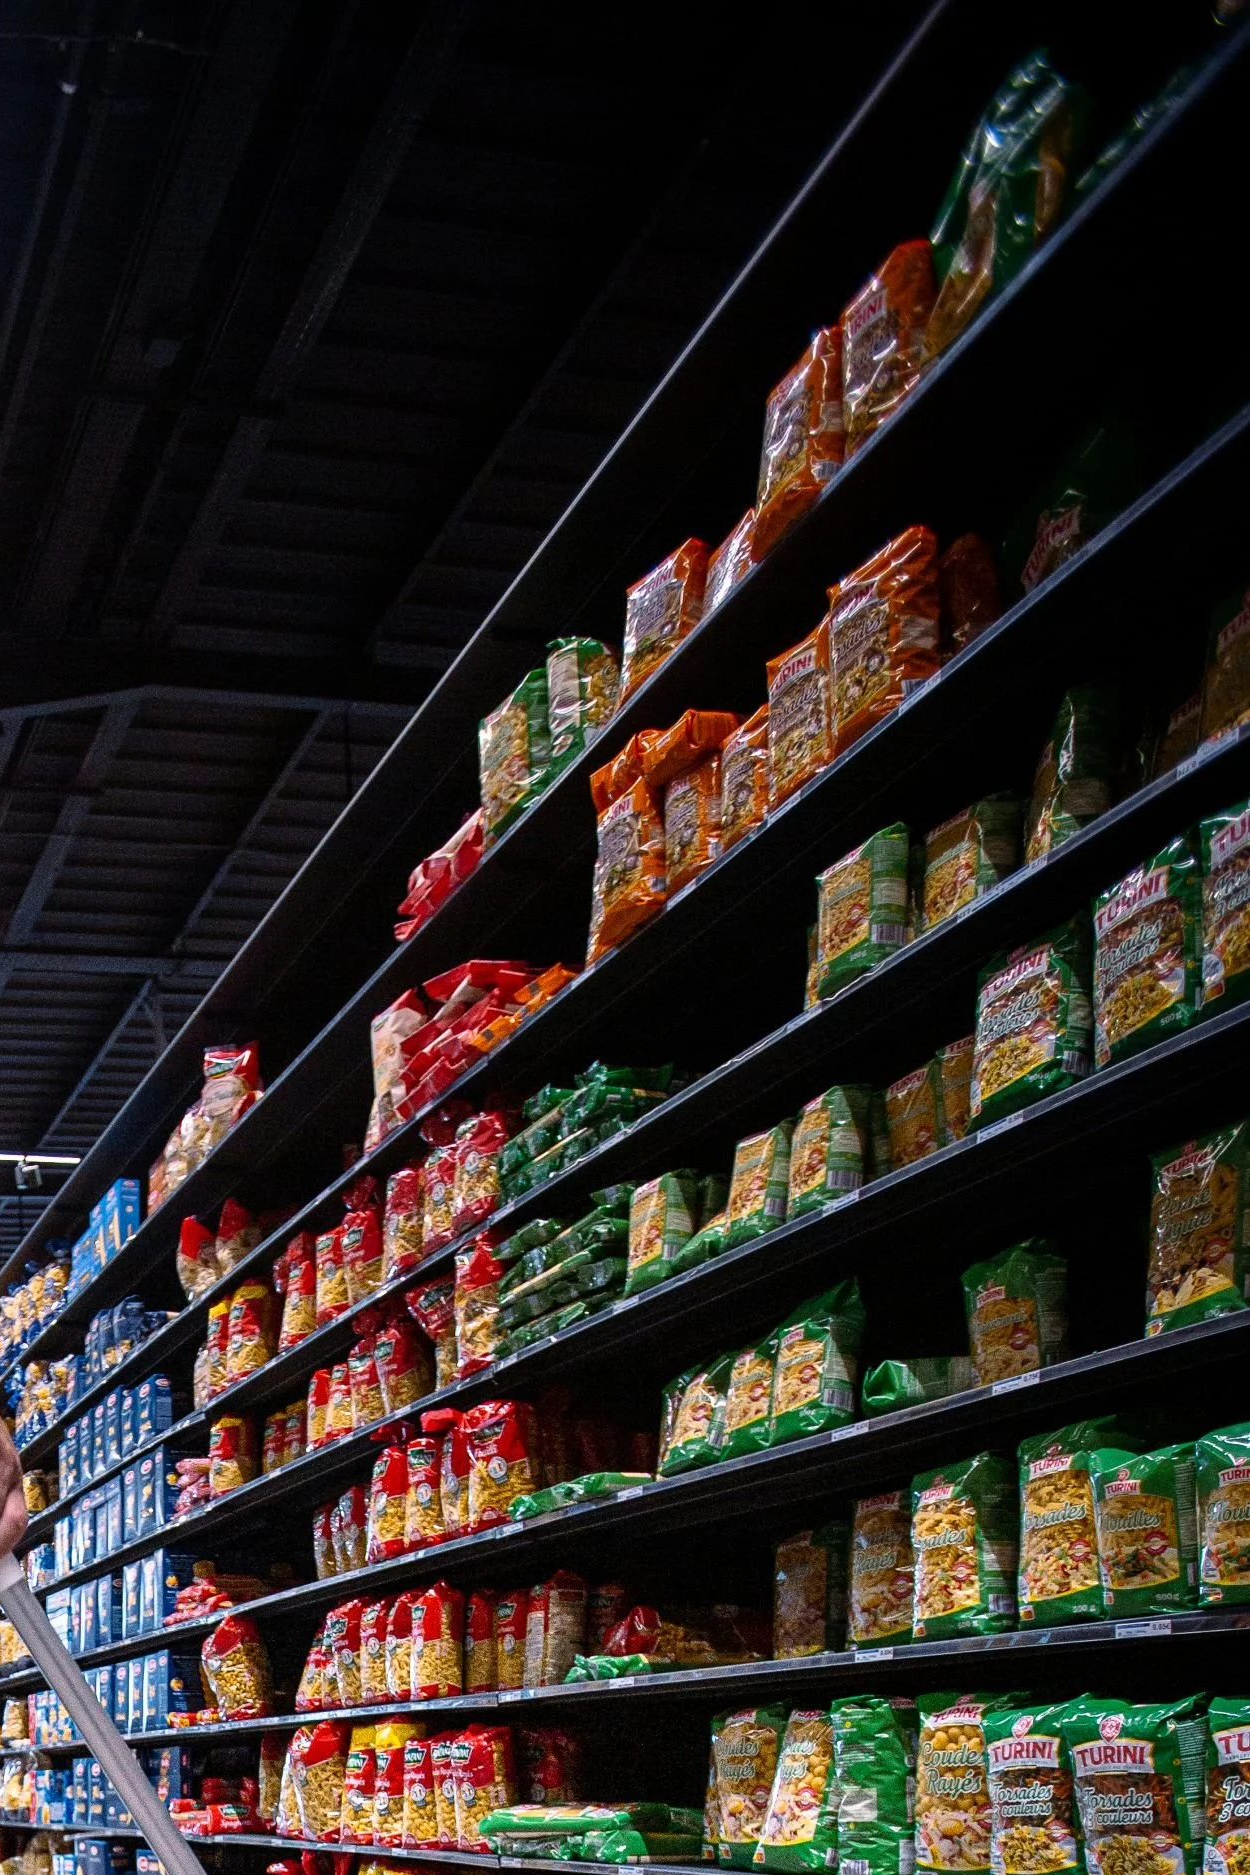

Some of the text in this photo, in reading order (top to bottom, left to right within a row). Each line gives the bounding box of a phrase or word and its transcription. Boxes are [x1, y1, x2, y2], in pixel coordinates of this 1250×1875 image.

[1096, 872, 1162, 930] TURINI
[1031, 1456, 1070, 1475] TURINI
[1105, 1481, 1139, 1494] TURINI
[933, 1705, 982, 1723] TURINI
[989, 1741, 1054, 1764] TURINI
[1076, 1745, 1147, 1769] TURINI
[924, 1771, 984, 1799] Rayés
[991, 1781, 1054, 1802] Torsades
[1082, 1787, 1153, 1809] Torsades
[1001, 1802, 1052, 1817] couleurs
[1095, 1809, 1153, 1826] couleurs
